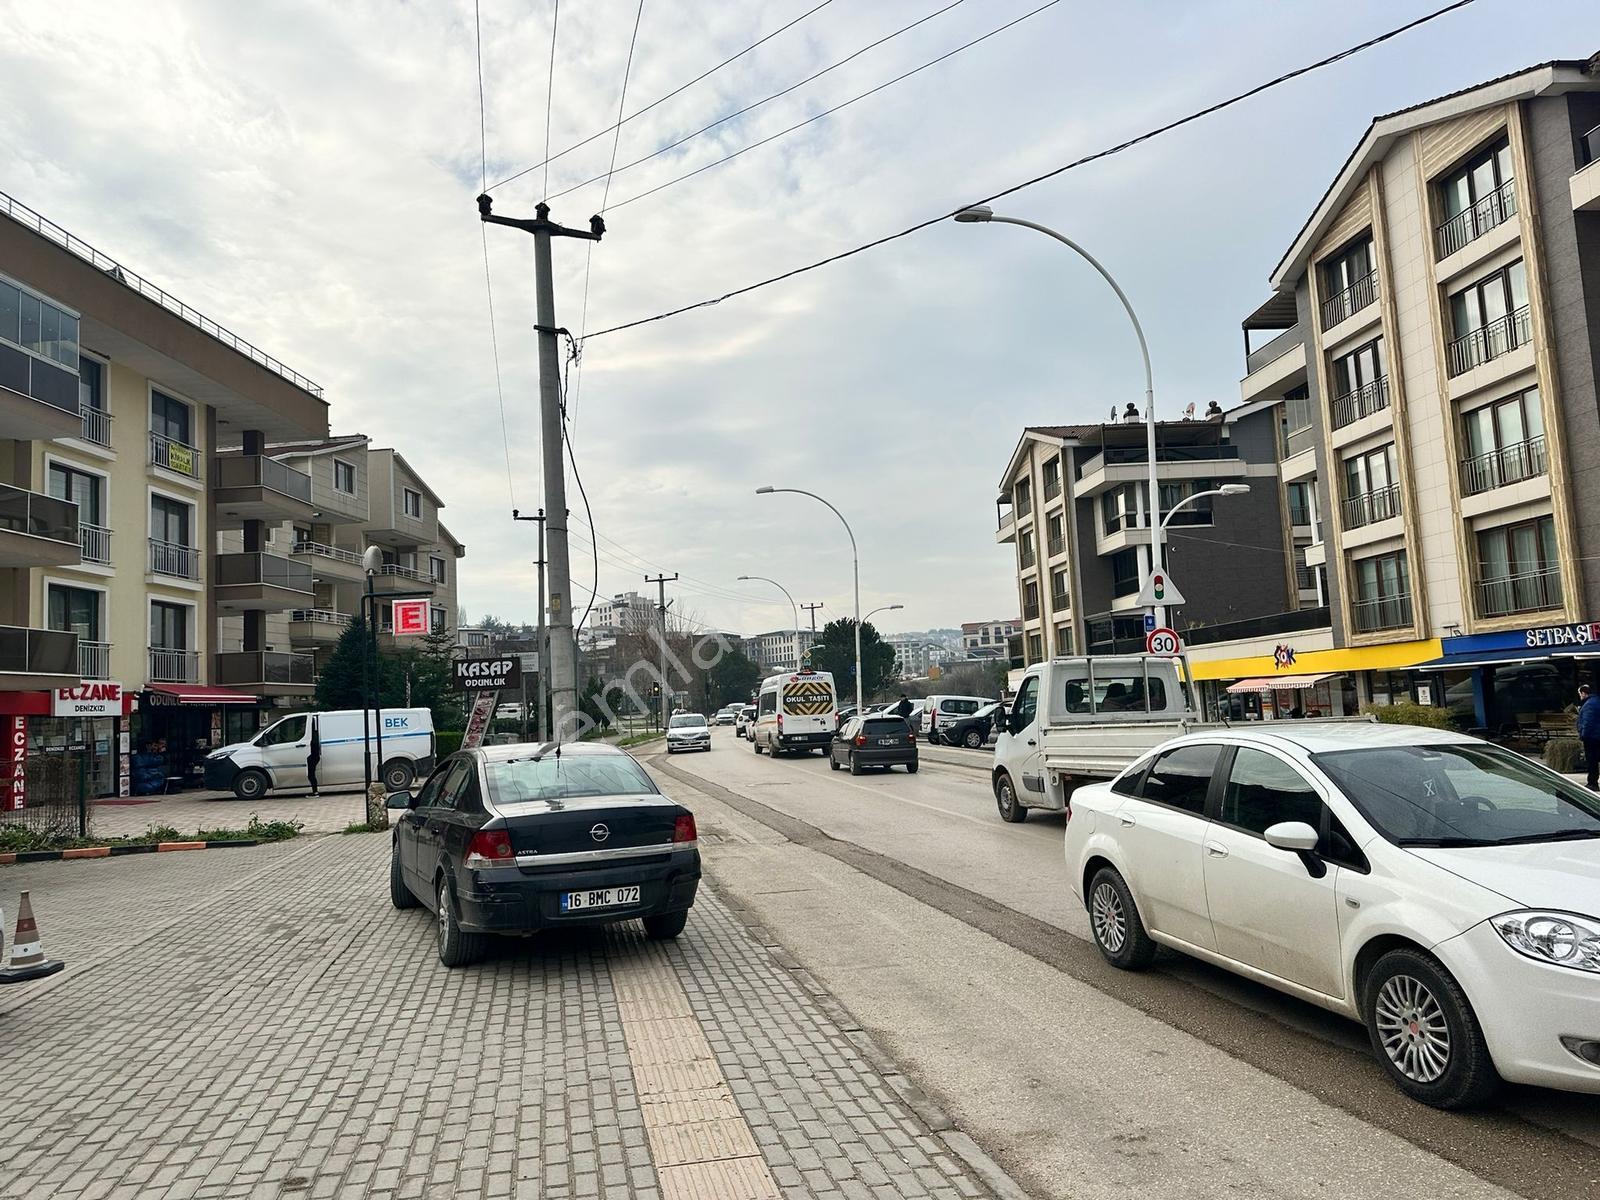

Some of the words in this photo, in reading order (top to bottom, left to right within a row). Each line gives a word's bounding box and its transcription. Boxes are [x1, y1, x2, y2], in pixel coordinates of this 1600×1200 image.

[402, 607, 421, 629] E
[1526, 624, 1592, 647] SETBAŞI
[1153, 637, 1174, 652] 30
[457, 661, 513, 677] KASAP
[465, 678, 506, 687] ODUNLUK
[59, 684, 121, 701] ECZANE
[74, 704, 106, 712] DENİZKIZI
[385, 718, 409, 728] BEK
[14, 716, 25, 809] ECZANE
[569, 894, 582, 908] 16
[588, 890, 611, 906] BMC
[617, 887, 639, 903] 072
